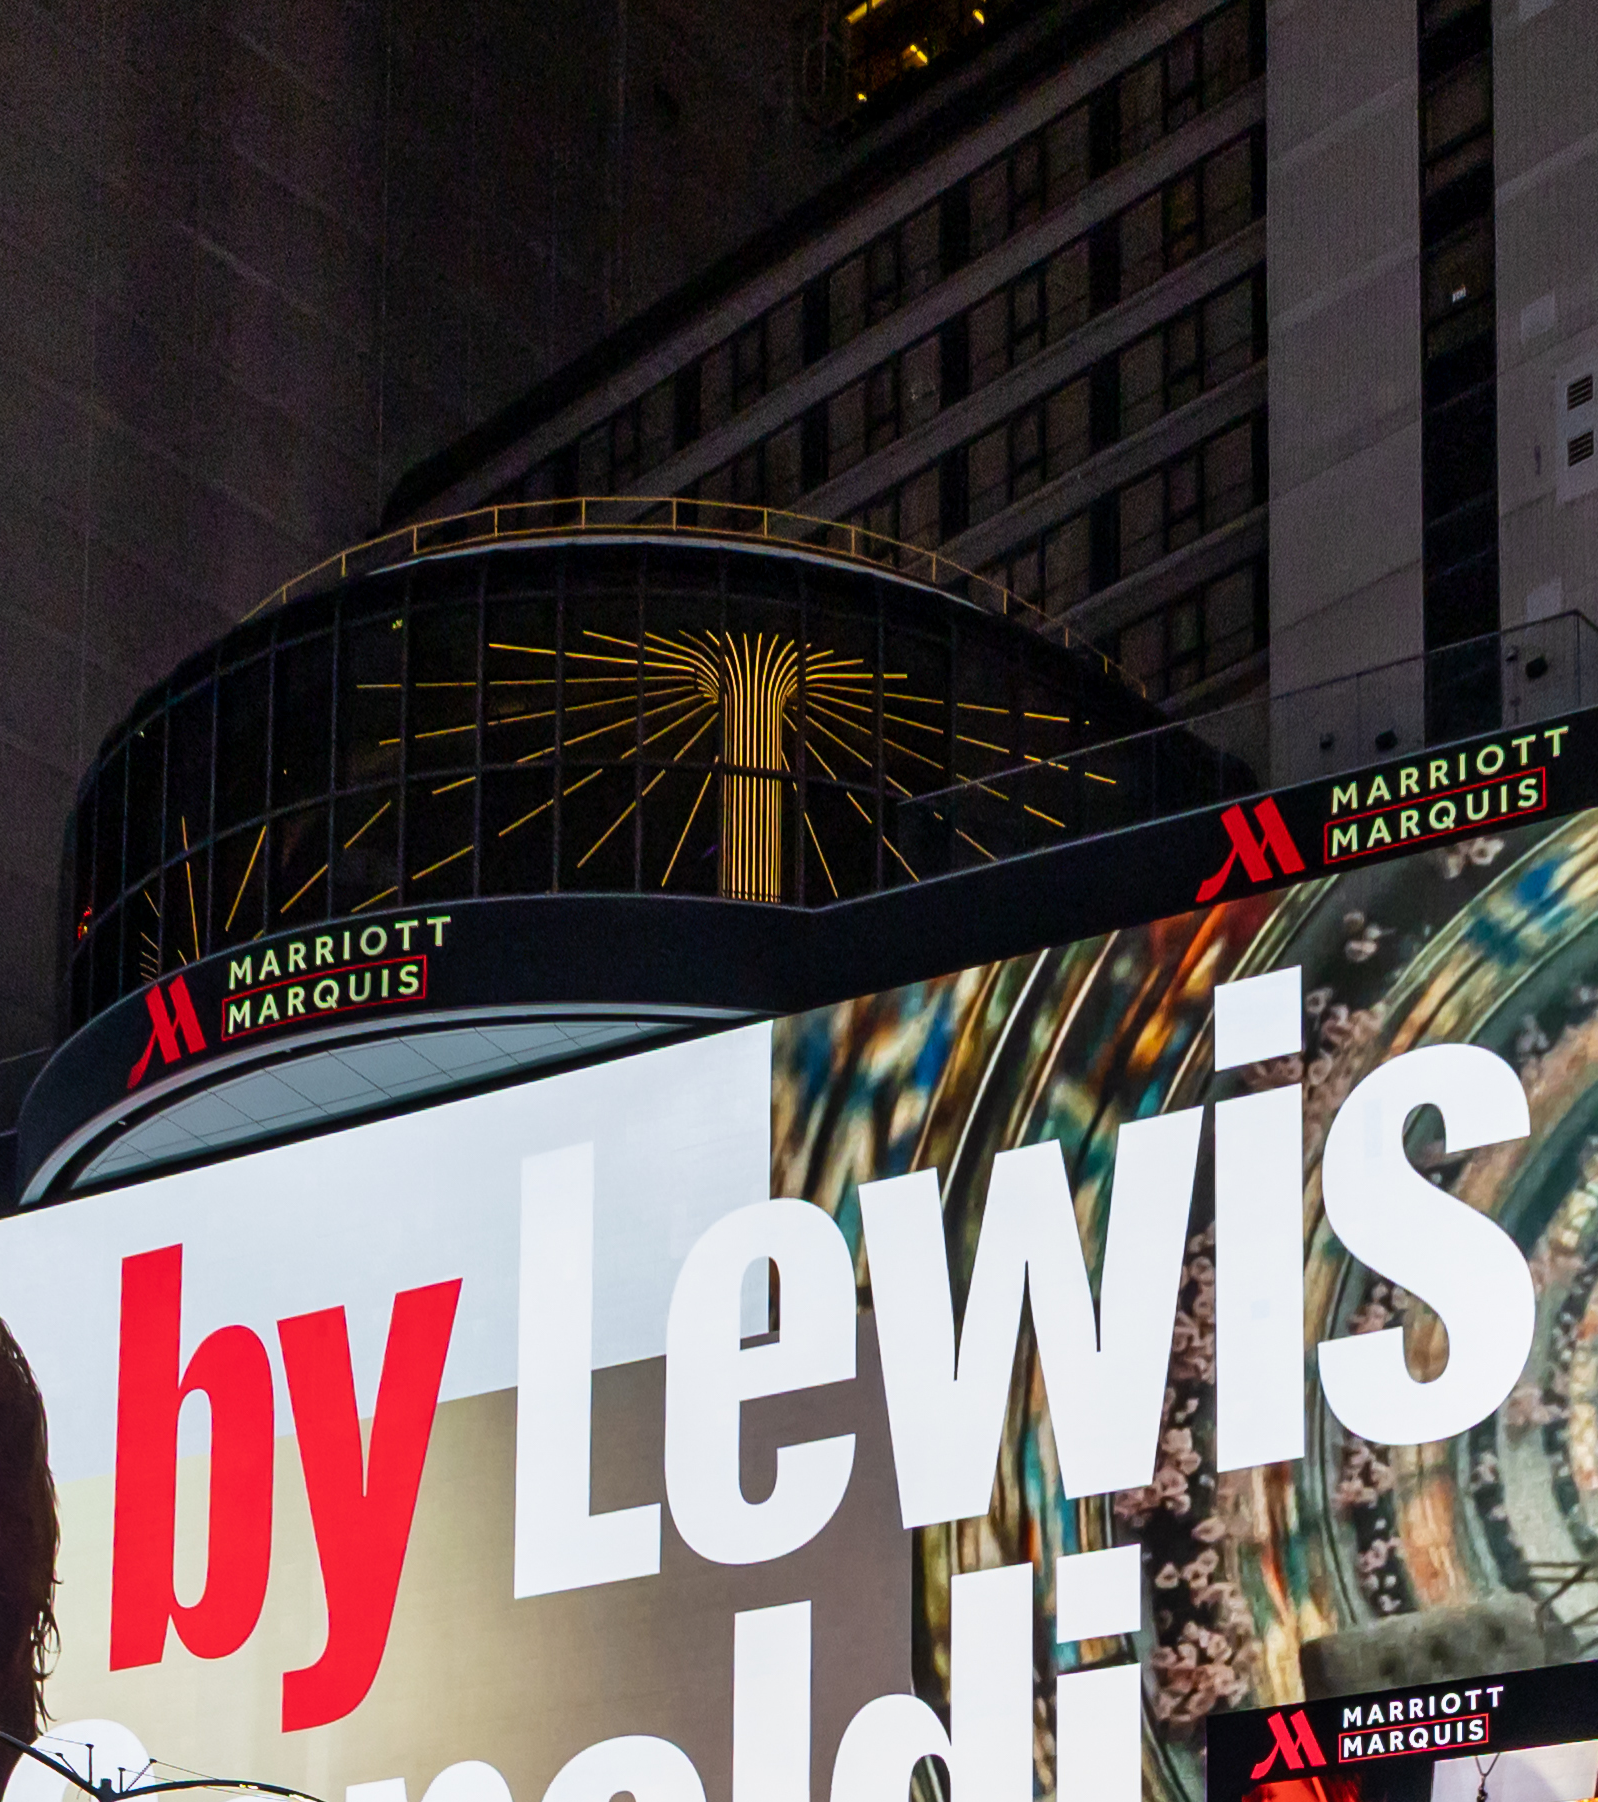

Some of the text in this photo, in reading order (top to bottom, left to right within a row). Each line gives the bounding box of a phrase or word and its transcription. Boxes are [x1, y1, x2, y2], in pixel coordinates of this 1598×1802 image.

[1331, 726, 1569, 814] MARRIOTT
[1331, 778, 1540, 857] MARQUIS
[227, 914, 452, 990] MARRIOTT
[226, 962, 422, 1037] MARQUIS
[110, 964, 1536, 1732] by Lewis
[1341, 1686, 1505, 1728] MARRIOTT
[1342, 1718, 1486, 1758] MARQUIS
